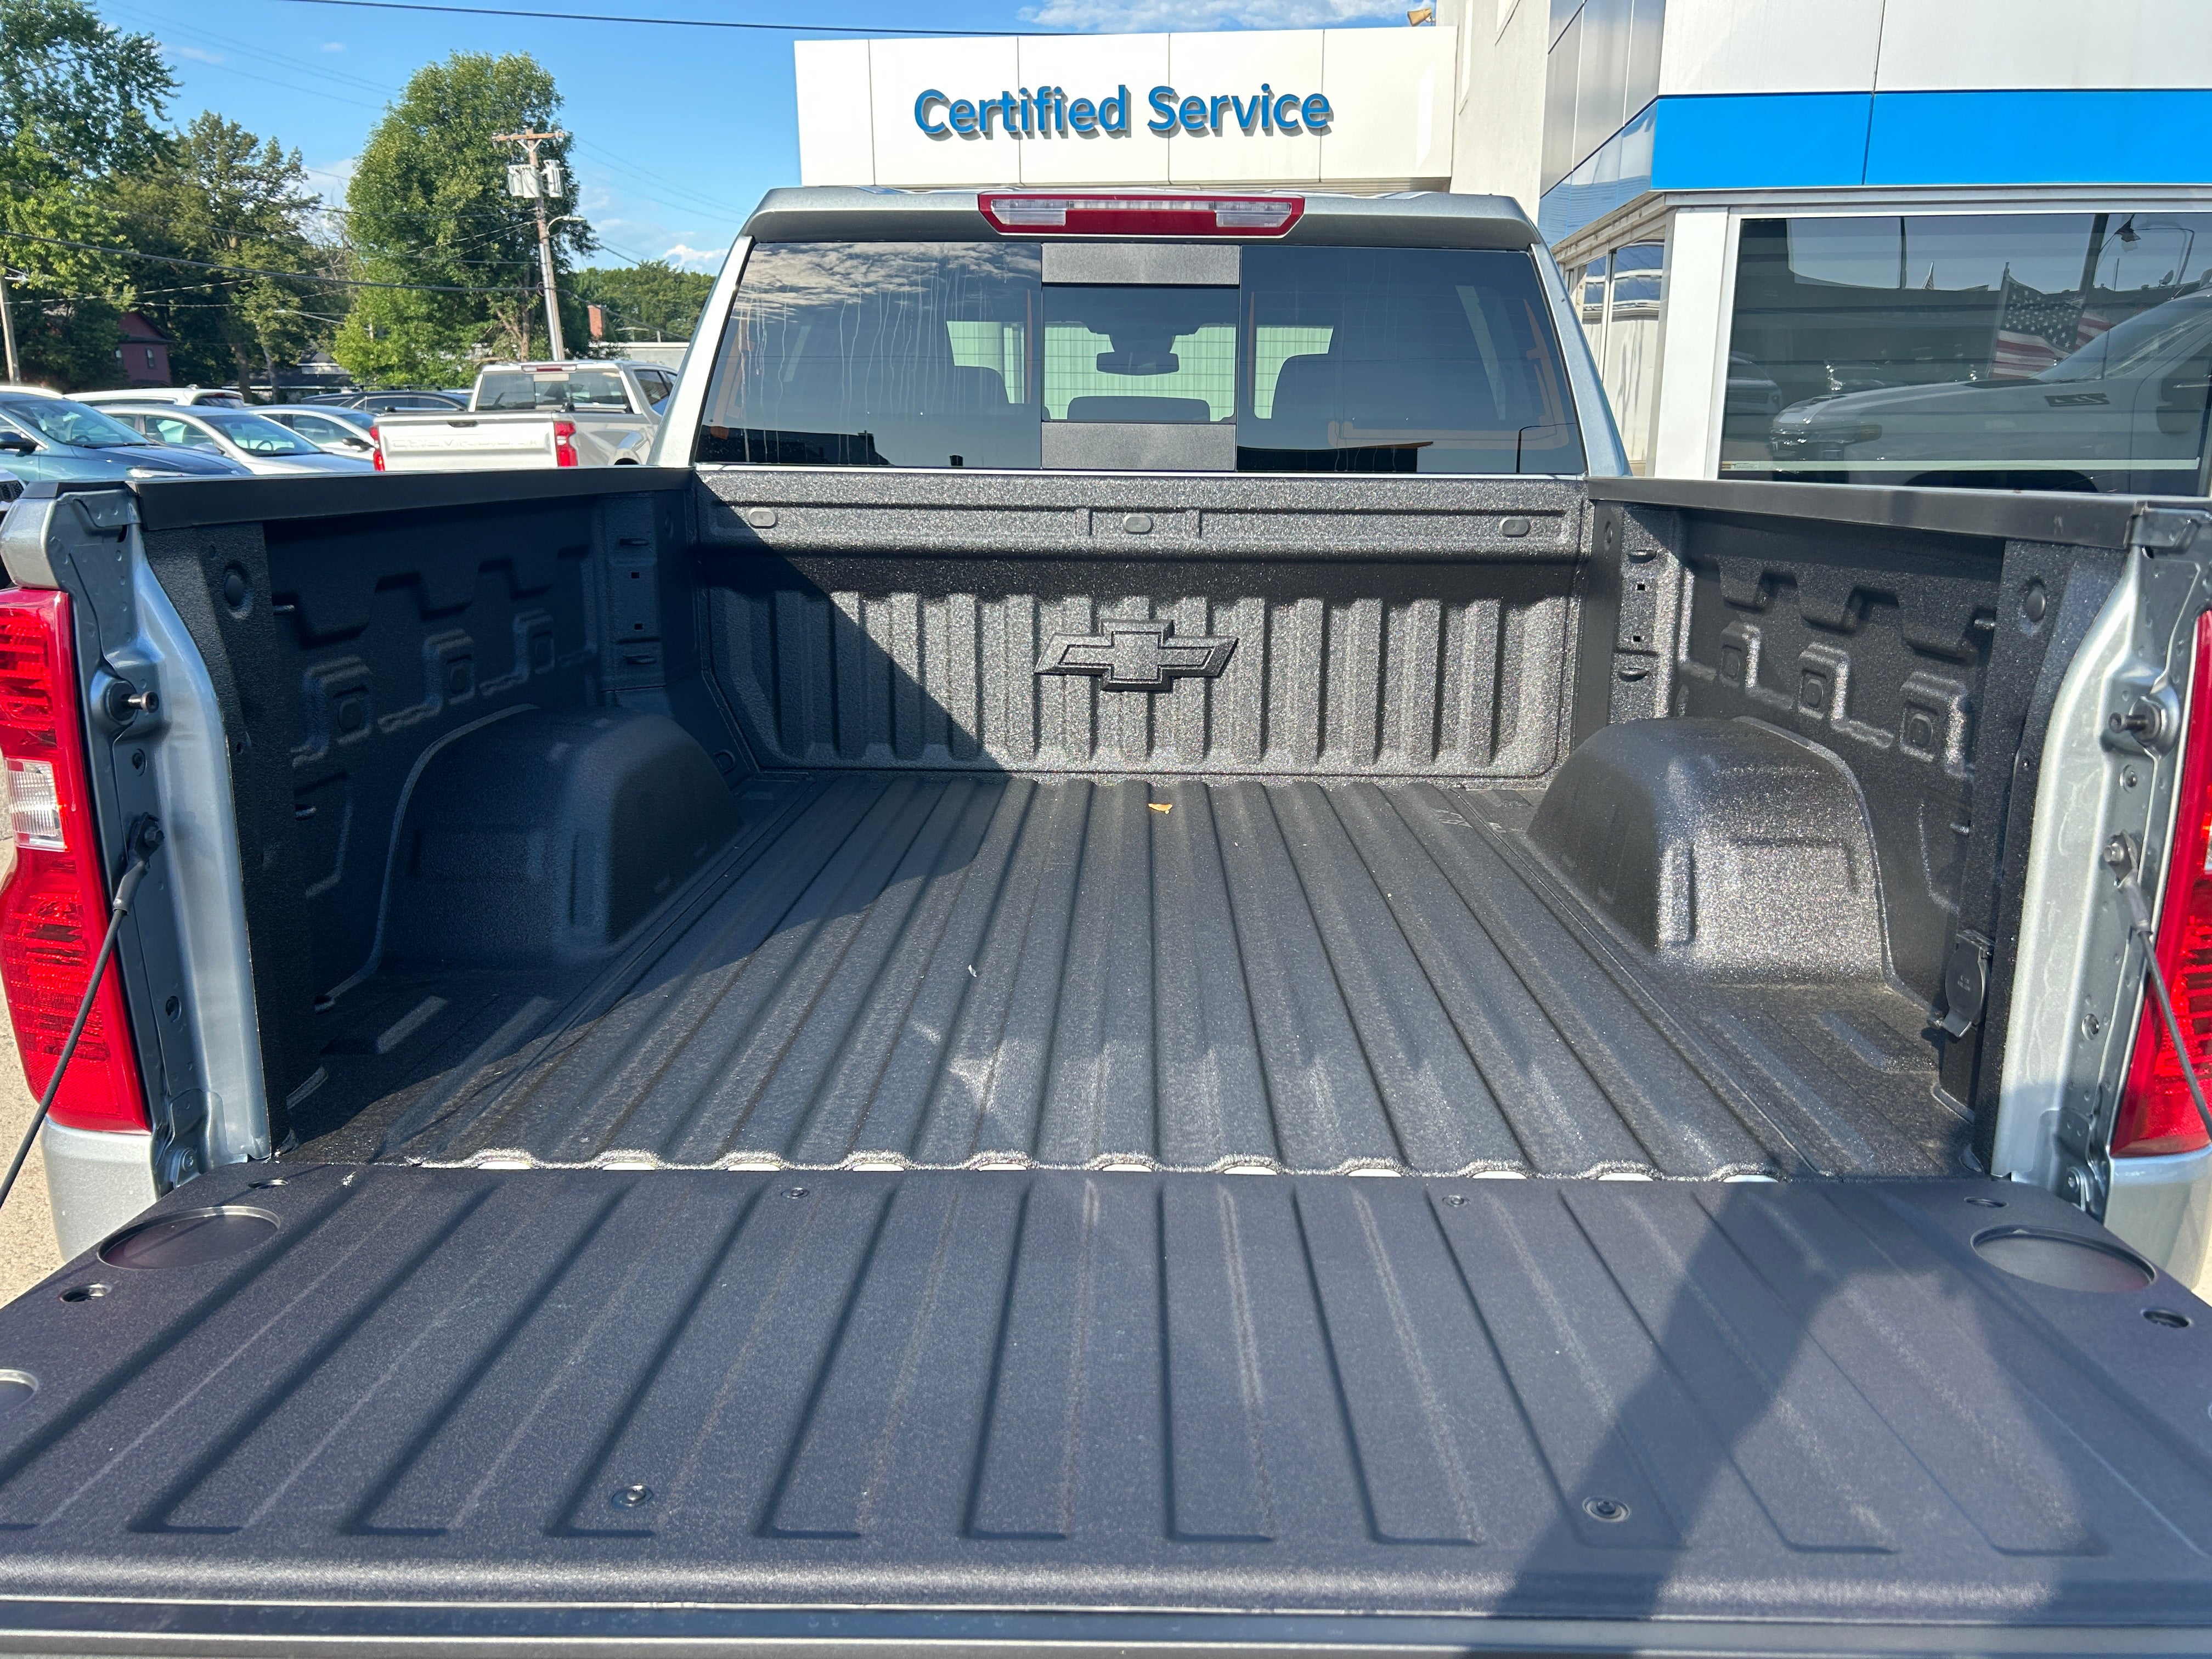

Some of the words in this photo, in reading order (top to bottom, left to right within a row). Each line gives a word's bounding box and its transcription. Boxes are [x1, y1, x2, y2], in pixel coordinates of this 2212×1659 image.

[915, 84, 1127, 134] Certified
[1147, 83, 1330, 131] Service
[391, 438, 538, 448] CHEVR
